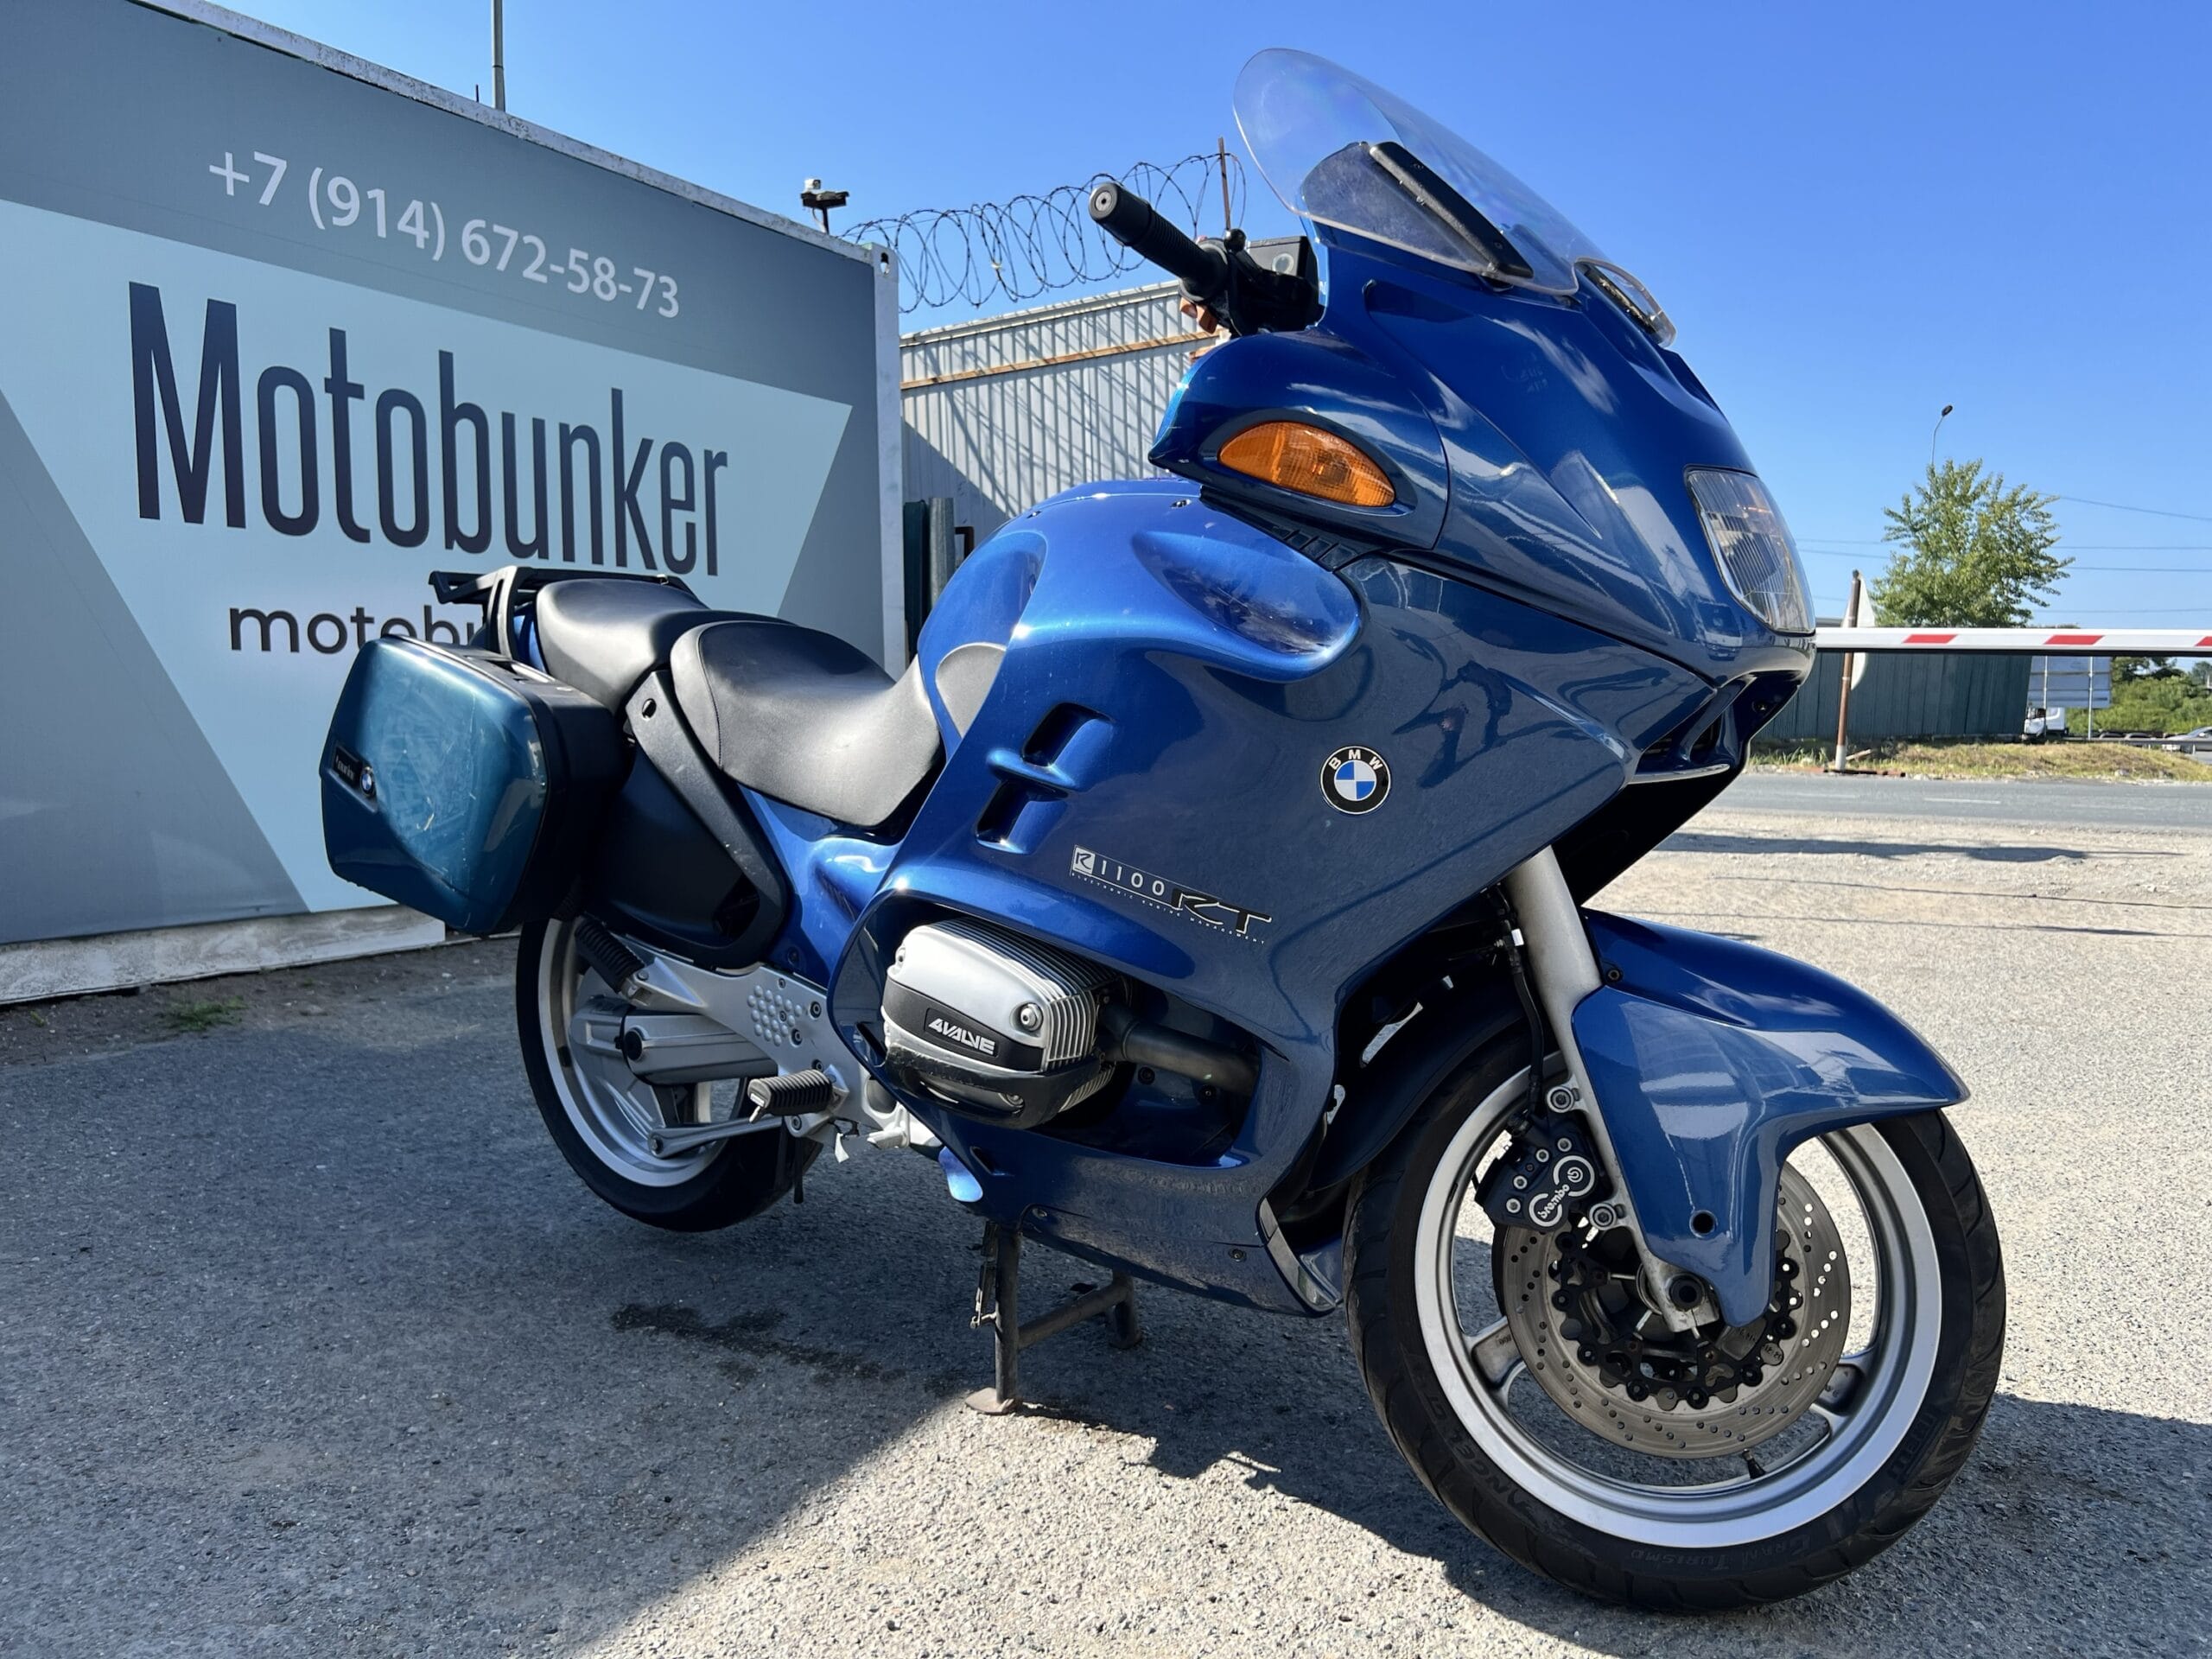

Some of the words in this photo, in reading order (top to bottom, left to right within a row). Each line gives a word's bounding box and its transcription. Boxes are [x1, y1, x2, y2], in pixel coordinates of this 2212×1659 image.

[209, 151, 287, 206] +7
[308, 167, 445, 261] (914)
[461, 219, 680, 319] 672-58-73
[129, 281, 728, 576] Motobunker
[1537, 1184, 1571, 1219] brembo
